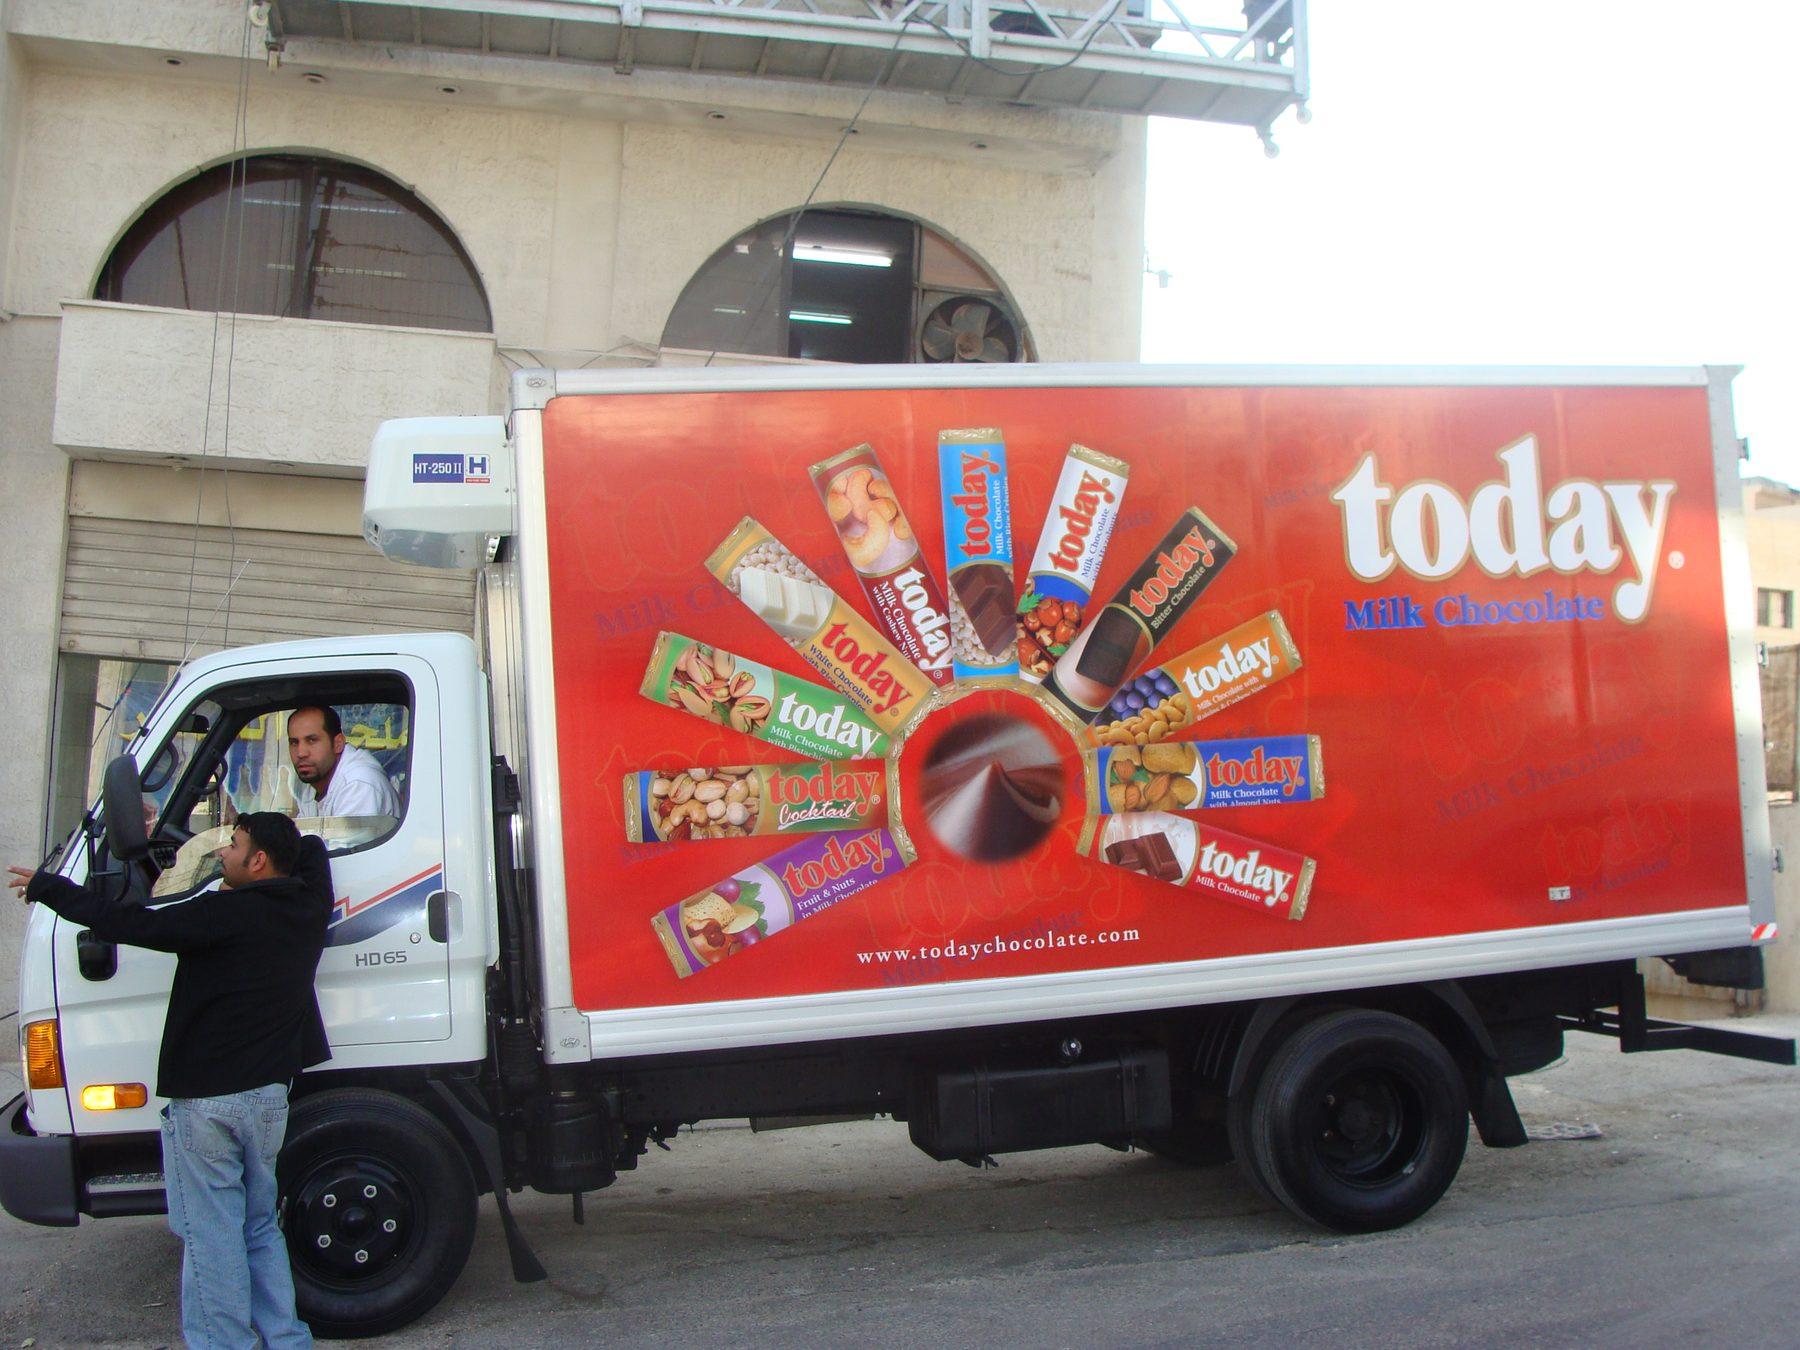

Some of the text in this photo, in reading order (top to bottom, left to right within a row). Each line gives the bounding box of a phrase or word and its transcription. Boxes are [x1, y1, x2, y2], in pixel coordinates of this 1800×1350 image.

[414, 462, 451, 475] HT-250
[951, 450, 1000, 558] today
[992, 480, 1005, 555] Milk Chocolate
[1048, 470, 1115, 573] today
[1330, 432, 1678, 625] today
[1081, 508, 1110, 578] Milk Chocolate
[1129, 525, 1215, 618] today
[880, 581, 921, 659] Milk Chocolate
[1150, 566, 1206, 629] Bitter Chocolate
[1344, 589, 1606, 631] Milk Chocolate
[810, 644, 873, 706] White Chocolate
[822, 623, 913, 715] today
[1182, 636, 1273, 699] today
[770, 725, 844, 758] Milk Chocolate
[1206, 745, 1303, 797] today
[767, 760, 880, 816] today
[778, 800, 858, 828] Cocktail
[1210, 787, 1279, 800] Milk Chocolate
[782, 828, 885, 898] today
[796, 877, 856, 911] Fruit & Nuts
[1195, 875, 1261, 903] Milk Chocolate
[1200, 840, 1295, 908] today
[856, 928, 1141, 964] www.todaychocolate.com
